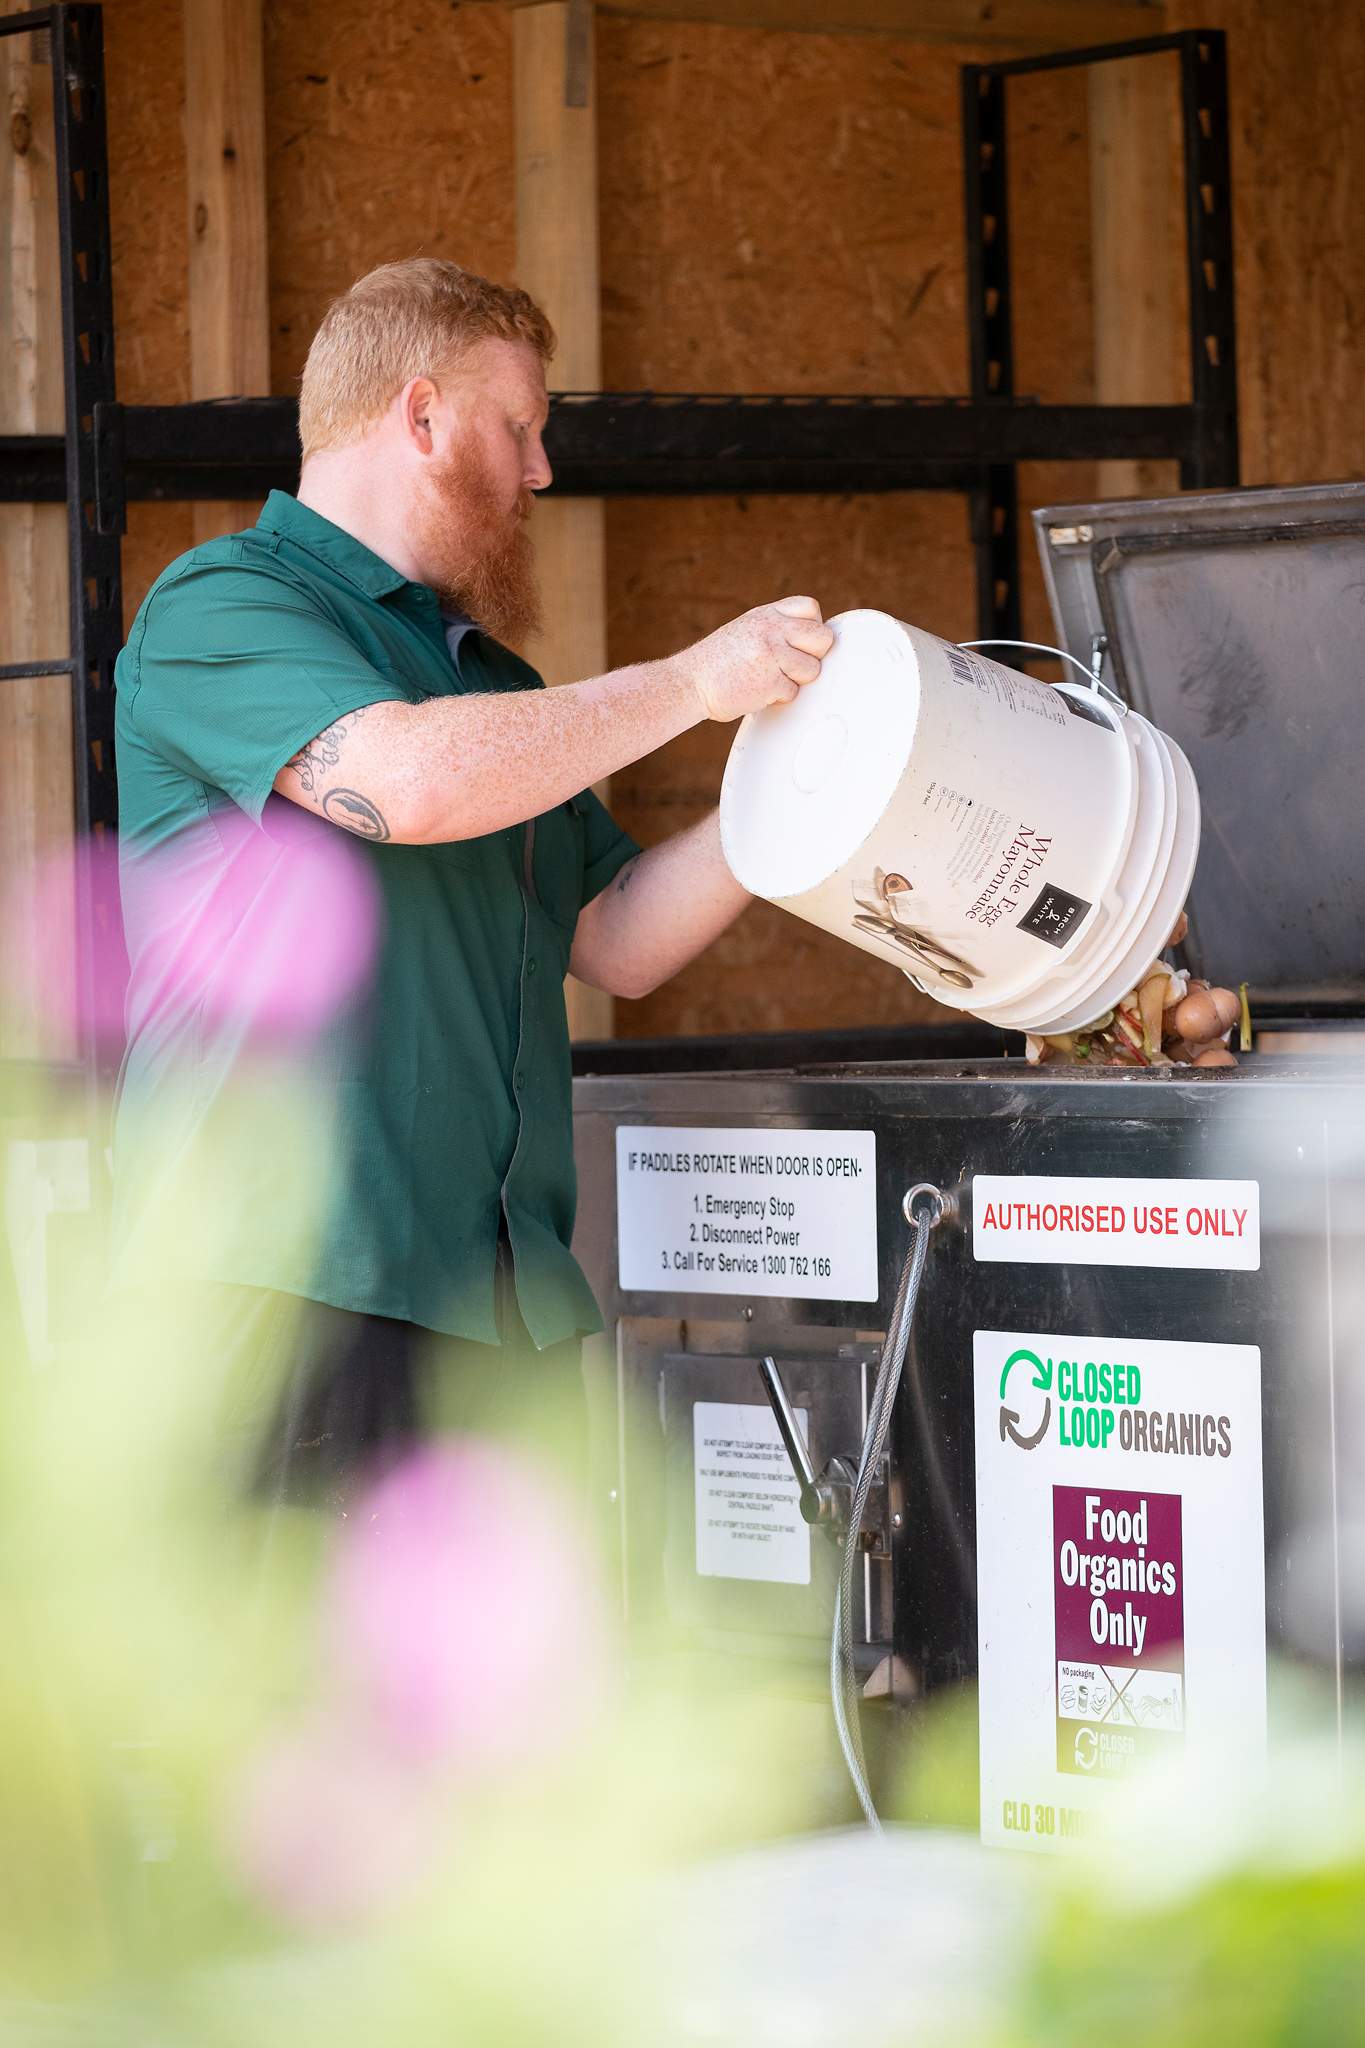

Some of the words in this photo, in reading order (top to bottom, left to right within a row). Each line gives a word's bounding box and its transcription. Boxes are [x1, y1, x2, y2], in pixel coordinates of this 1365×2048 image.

[966, 823, 1035, 919] Mayonnaise
[1009, 838, 1052, 894] Whole
[978, 896, 1018, 927] Egg
[1032, 898, 1054, 924] WAITE
[1045, 909, 1060, 921] &
[1054, 907, 1075, 934] BIRCH
[628, 1152, 638, 1171] IF
[641, 1153, 690, 1173] PADDLES
[693, 1154, 736, 1174] ROTATE
[739, 1155, 773, 1175] WHEN
[776, 1156, 809, 1176] DOOR
[812, 1157, 823, 1177] IS
[694, 1194, 703, 1214] 1.
[706, 1195, 765, 1219] Emergency
[770, 1197, 795, 1221] Stop
[982, 1203, 1126, 1233] AUTHORISED
[1133, 1206, 1178, 1235] USE
[1186, 1208, 1248, 1237] ONLY
[690, 1223, 699, 1242] 2.
[703, 1224, 763, 1245] Disconnect
[766, 1228, 800, 1246] Power
[661, 1251, 671, 1269] 3.
[674, 1252, 694, 1271] Call
[697, 1253, 715, 1272] For
[719, 1254, 758, 1274] Service
[762, 1255, 786, 1275] 1300
[790, 1257, 809, 1276] 762
[812, 1257, 831, 1277] 166
[1058, 1361, 1141, 1405] CLOSED
[1059, 1406, 1114, 1449] LOOP
[1119, 1410, 1232, 1458] ORGANICS
[1085, 1495, 1148, 1545] Food
[1060, 1540, 1176, 1597] Organics
[1089, 1598, 1147, 1656] Only
[1070, 1668, 1095, 1680] packaging
[1100, 1733, 1135, 1754] CLOSED
[1003, 1800, 1031, 1832] CLO
[1035, 1803, 1055, 1835] 30
